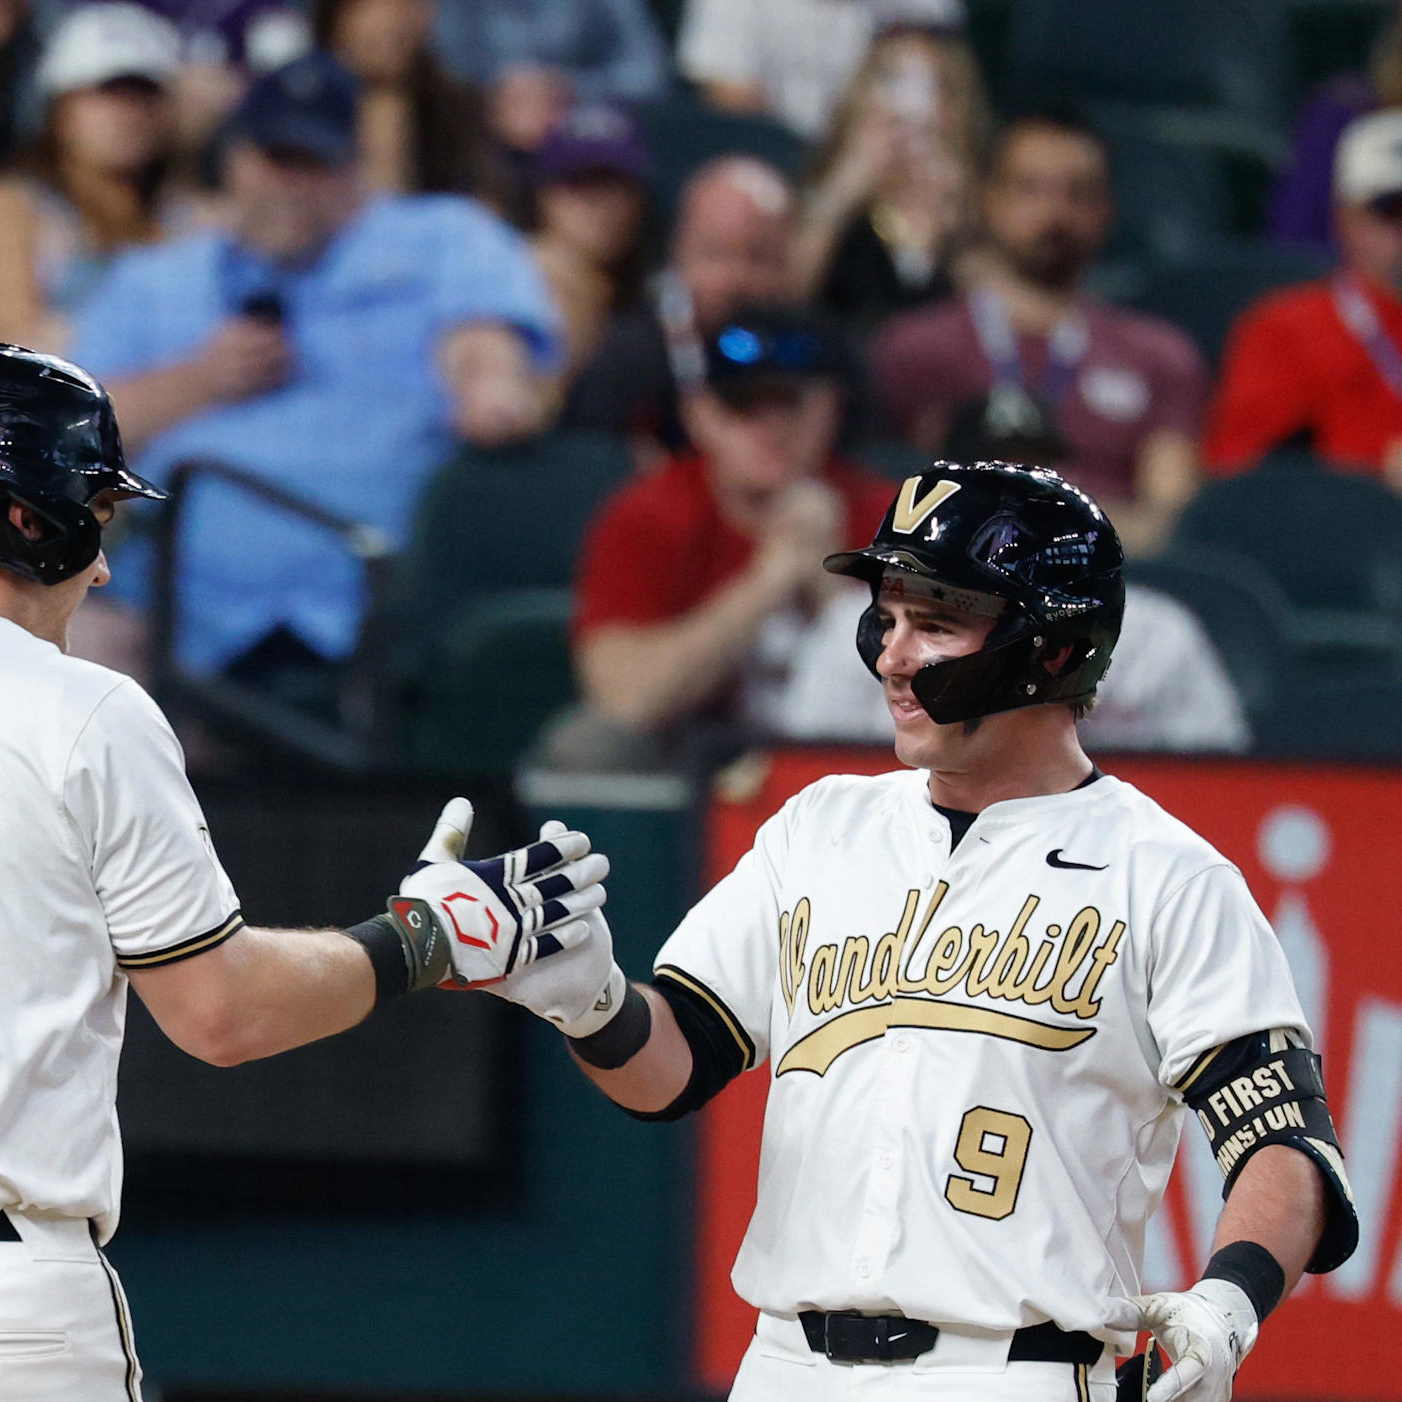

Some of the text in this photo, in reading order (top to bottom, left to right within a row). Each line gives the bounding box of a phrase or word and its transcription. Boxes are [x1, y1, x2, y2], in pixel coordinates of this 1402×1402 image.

[892, 475, 962, 535] V
[778, 880, 1125, 1019] Vanderbilt
[1207, 1059, 1295, 1128] FIRST
[944, 1105, 1033, 1221] 9
[1216, 1101, 1306, 1180] HNSTON
